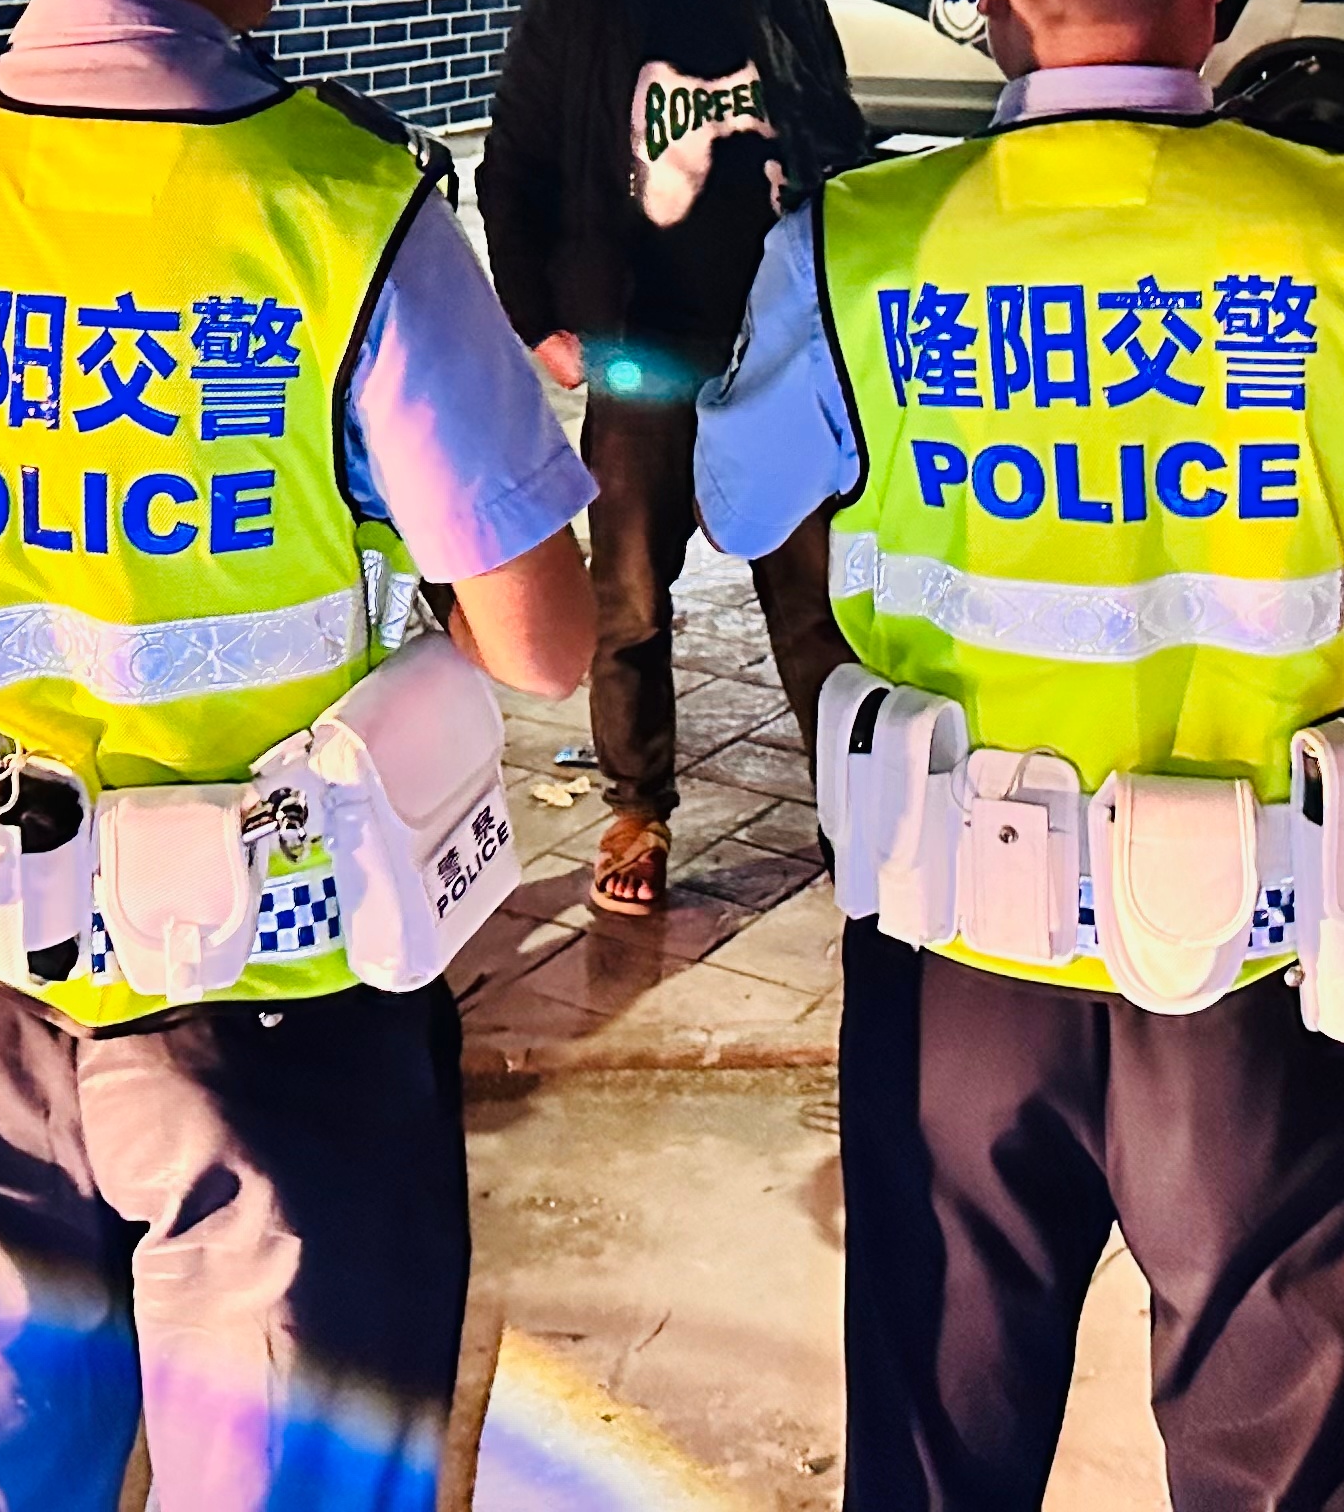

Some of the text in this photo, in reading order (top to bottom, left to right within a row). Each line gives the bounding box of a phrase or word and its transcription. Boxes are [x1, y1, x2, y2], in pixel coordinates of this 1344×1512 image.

[877, 274, 1318, 411] 隆阳交警
[911, 441, 1301, 524] POLICE
[436, 805, 496, 888] 警察
[436, 820, 510, 919] POLICE
